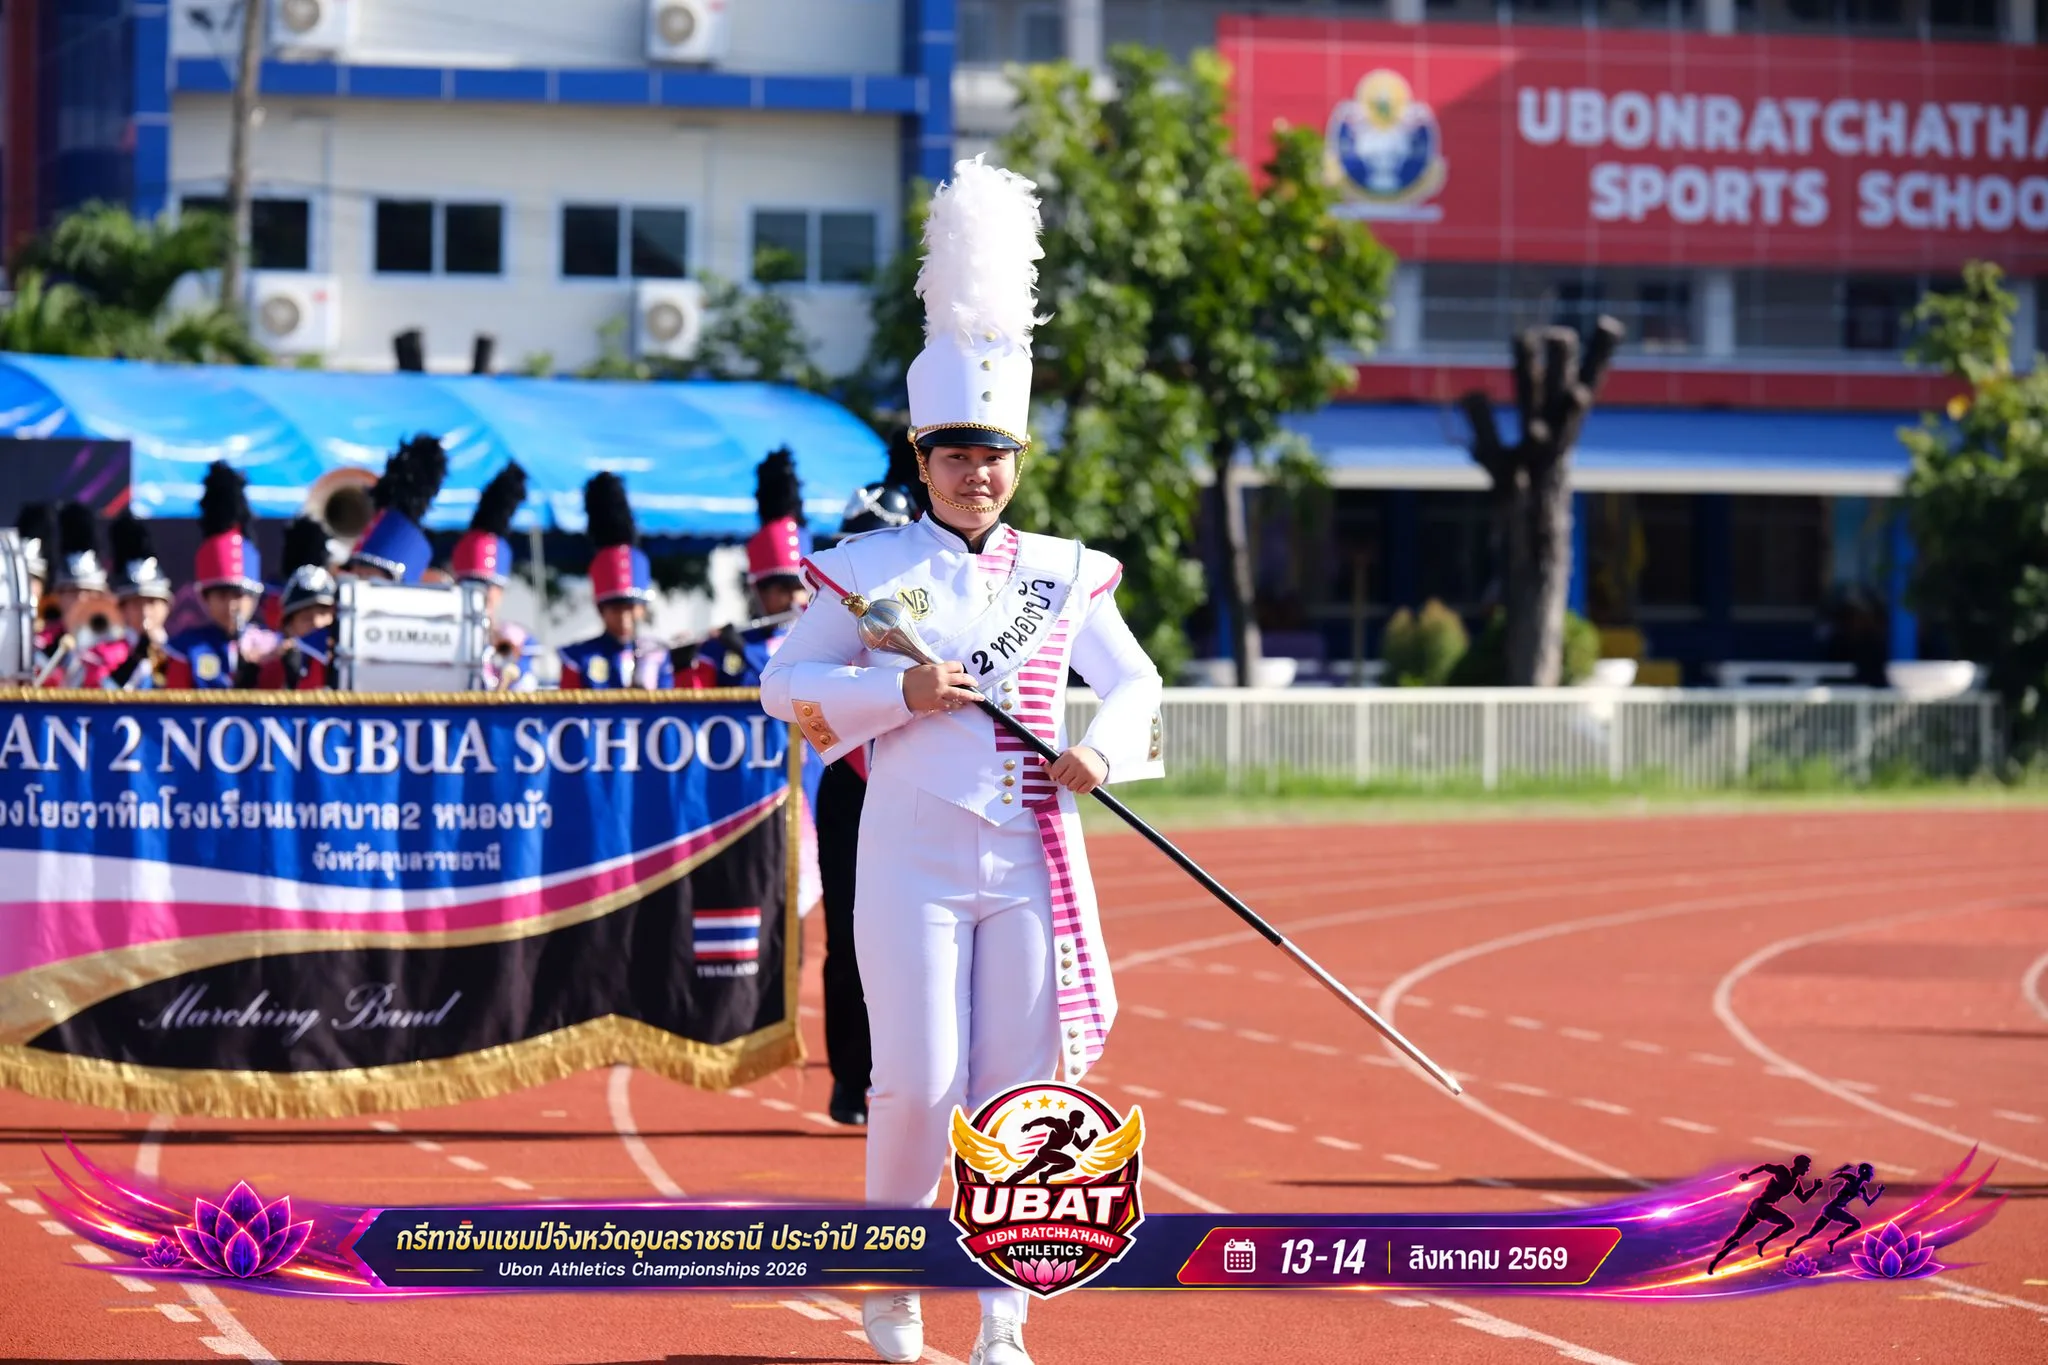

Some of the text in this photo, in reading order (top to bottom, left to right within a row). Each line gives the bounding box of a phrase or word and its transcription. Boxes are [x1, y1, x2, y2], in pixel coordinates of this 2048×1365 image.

[1590, 162, 1828, 226] SPORTS
[971, 579, 1055, 676] 2 หนองบัว
[0, 713, 785, 774] AN 2 NONGBUA SCHOOL
[432, 789, 553, 830] หนองบัว
[138, 982, 463, 1047] Marching Band
